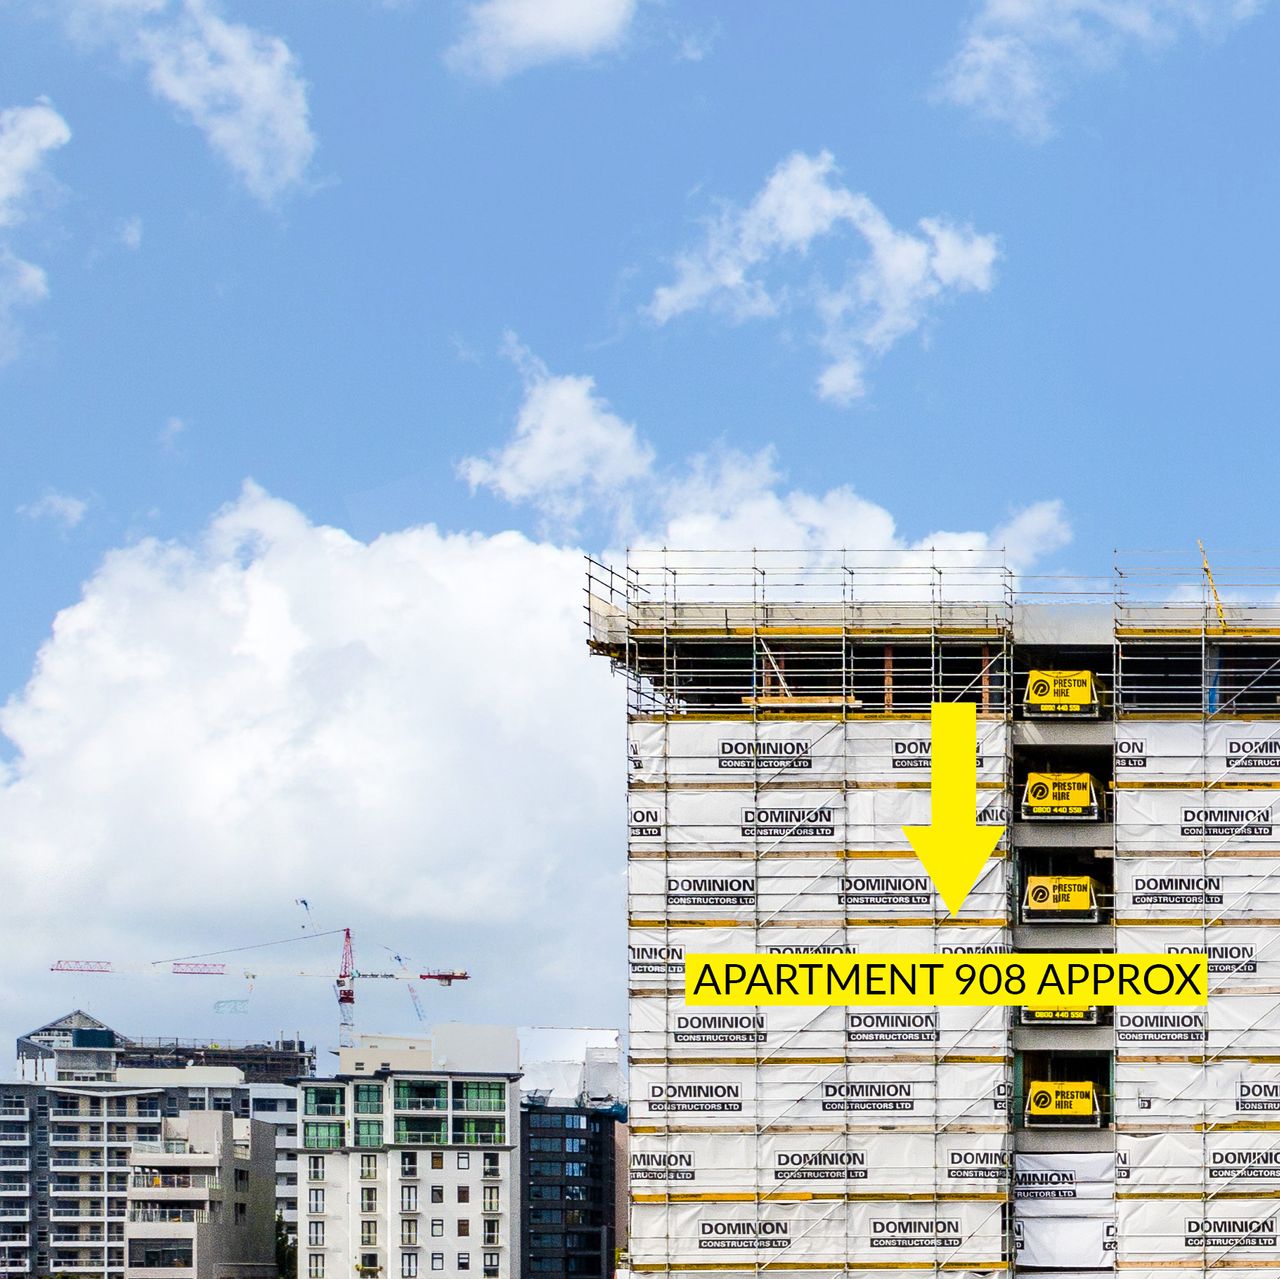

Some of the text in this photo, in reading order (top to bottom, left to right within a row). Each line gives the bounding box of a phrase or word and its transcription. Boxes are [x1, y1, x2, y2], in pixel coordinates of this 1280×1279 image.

[1053, 679, 1087, 687] PRESTON
[1053, 688, 1069, 697] HIRE
[1052, 782, 1087, 791] PRESTON
[1052, 792, 1070, 800] HIRE
[667, 879, 754, 891] DOMINION
[1052, 884, 1088, 893] PRESTON
[1135, 878, 1220, 890] DOMINION
[1052, 894, 1070, 903] HIRE
[677, 1016, 764, 1028] DOMINION
[1120, 1015, 1205, 1027] DOMINION
[652, 1085, 739, 1098] DOMINION
[1055, 1090, 1090, 1100] PRESTON
[1055, 1100, 1073, 1109] HIRE
[778, 1153, 864, 1166] DOMINION
[702, 1222, 787, 1235] DOMINION
[873, 1221, 959, 1233] DOMINION
